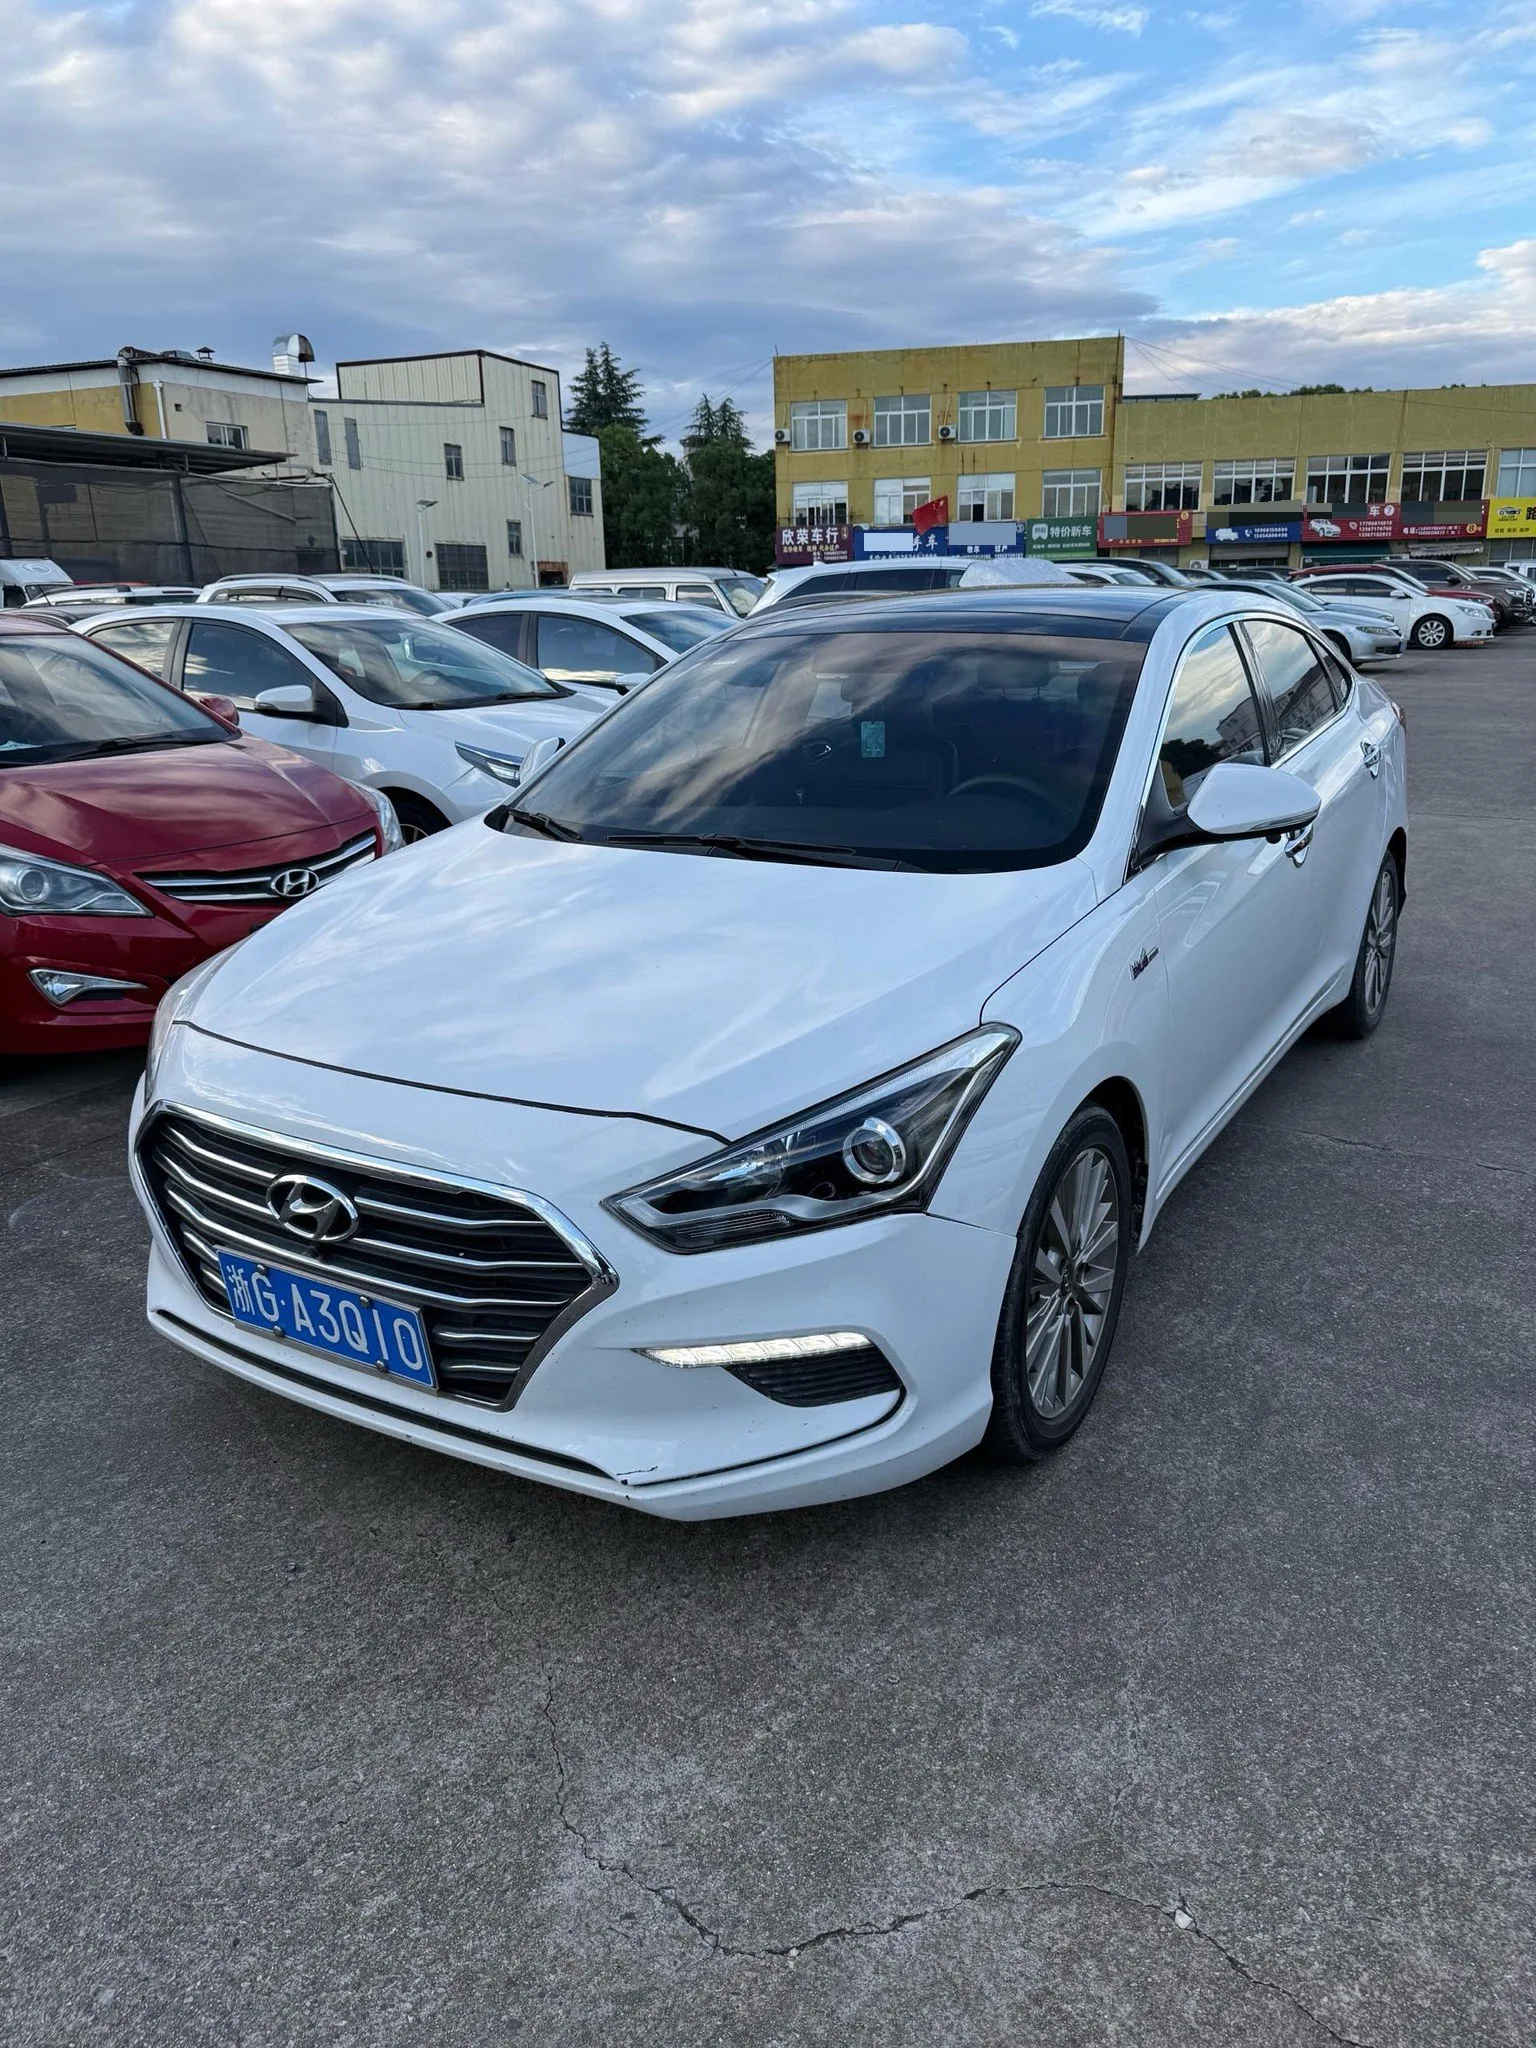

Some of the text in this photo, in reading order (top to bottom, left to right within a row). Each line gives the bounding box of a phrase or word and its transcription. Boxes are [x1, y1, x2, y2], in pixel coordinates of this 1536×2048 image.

[1369, 505, 1380, 517] 车
[782, 527, 838, 545] 欣荣车行
[1050, 525, 1092, 538] 特价新车
